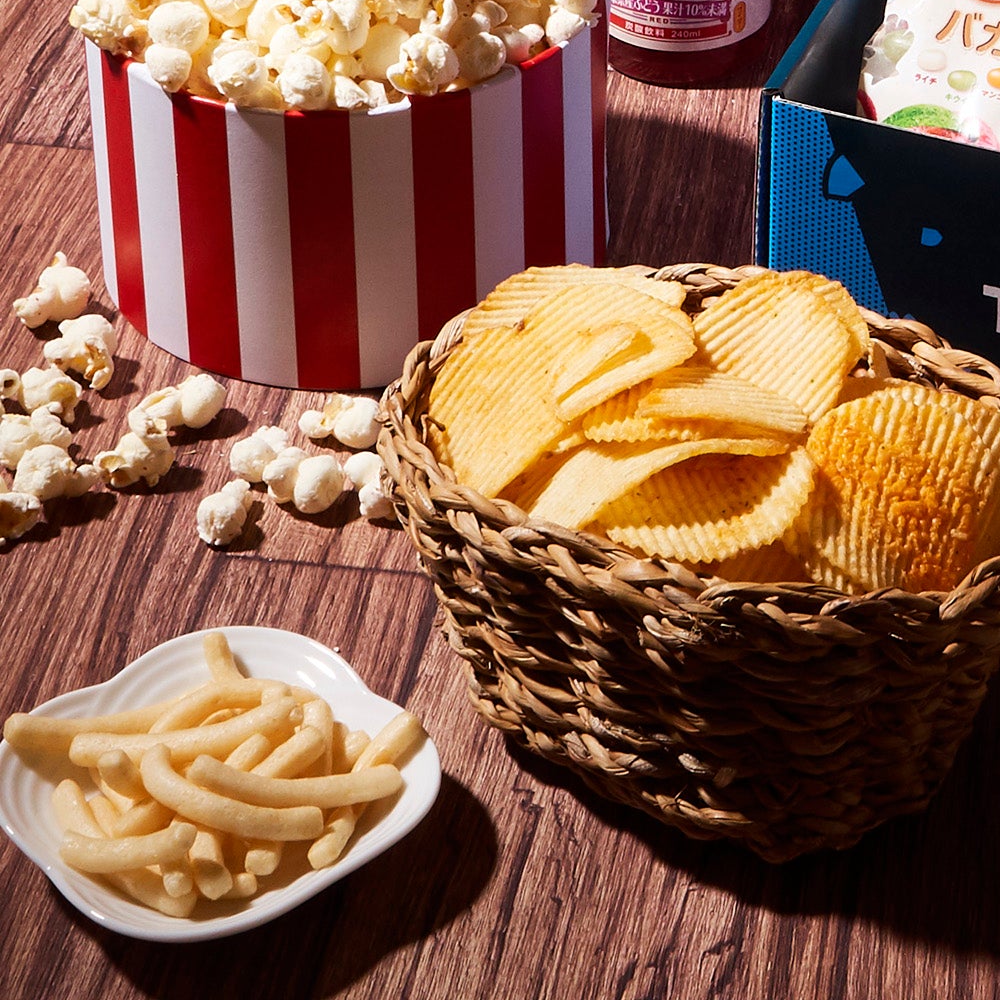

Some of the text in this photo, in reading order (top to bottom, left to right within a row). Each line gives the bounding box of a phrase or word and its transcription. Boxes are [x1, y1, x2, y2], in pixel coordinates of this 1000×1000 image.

[671, 29, 701, 40] 240ml
[914, 73, 938, 86] ライチ
